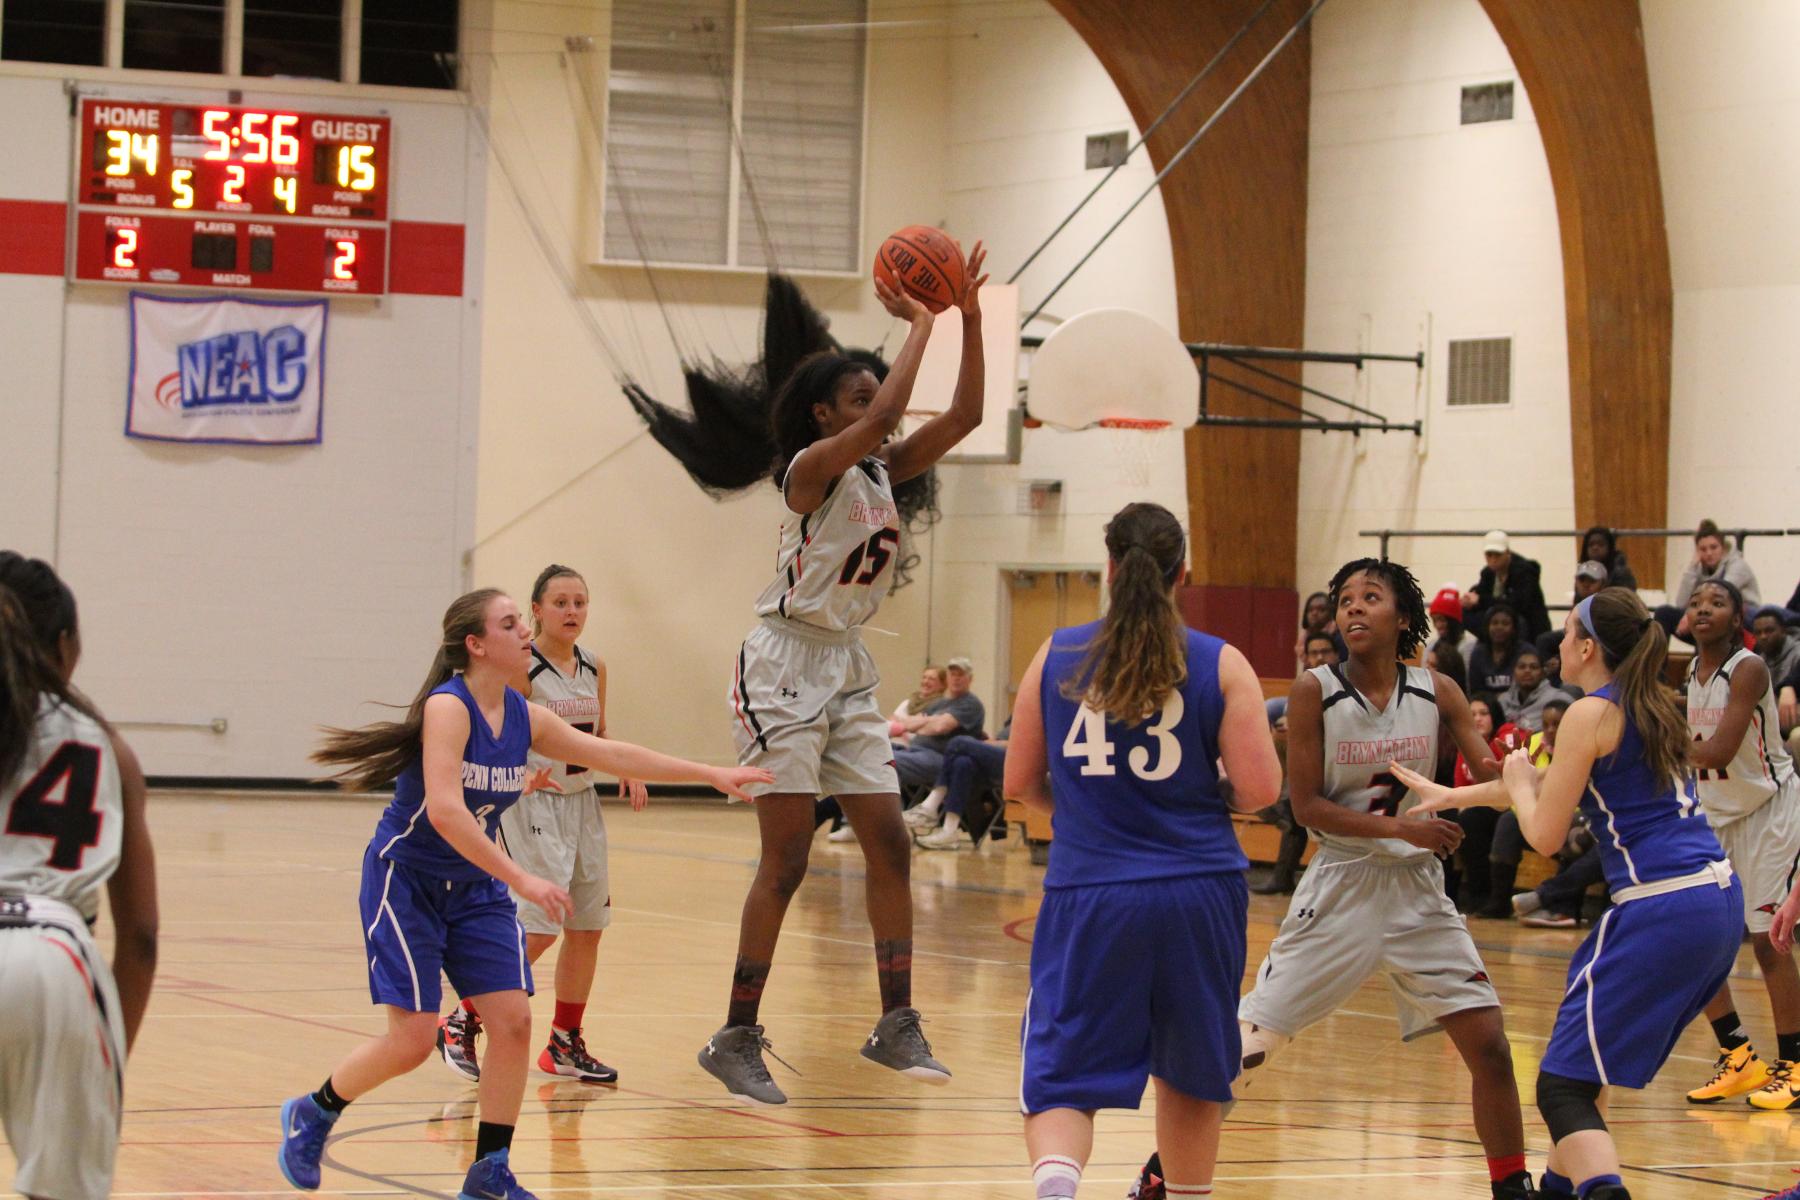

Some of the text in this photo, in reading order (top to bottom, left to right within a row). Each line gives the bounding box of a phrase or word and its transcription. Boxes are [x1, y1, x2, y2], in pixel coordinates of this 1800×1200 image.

[94, 106, 160, 129] HOME
[311, 119, 382, 142] GUEST
[105, 129, 159, 177] 34
[202, 110, 299, 165] 5:56
[223, 165, 245, 203] 2
[337, 144, 375, 191] 15
[116, 192, 156, 206] BONUS
[171, 169, 194, 209] 5
[273, 176, 297, 214] 4
[105, 215, 141, 228] FOULS
[312, 203, 350, 216] BONUS
[194, 220, 236, 234] PLAYER
[248, 223, 276, 237] FOUL
[324, 228, 359, 241] FOULS
[114, 228, 138, 268] 2
[333, 241, 356, 279] 2
[103, 267, 140, 279] SCORE
[212, 272, 252, 285] MATCH
[322, 278, 359, 291] SCORE
[911, 265, 941, 293] THE
[178, 323, 308, 411] NEAC
[837, 526, 899, 586] 15
[1062, 686, 1185, 781] 43
[4, 740, 104, 872] 4
